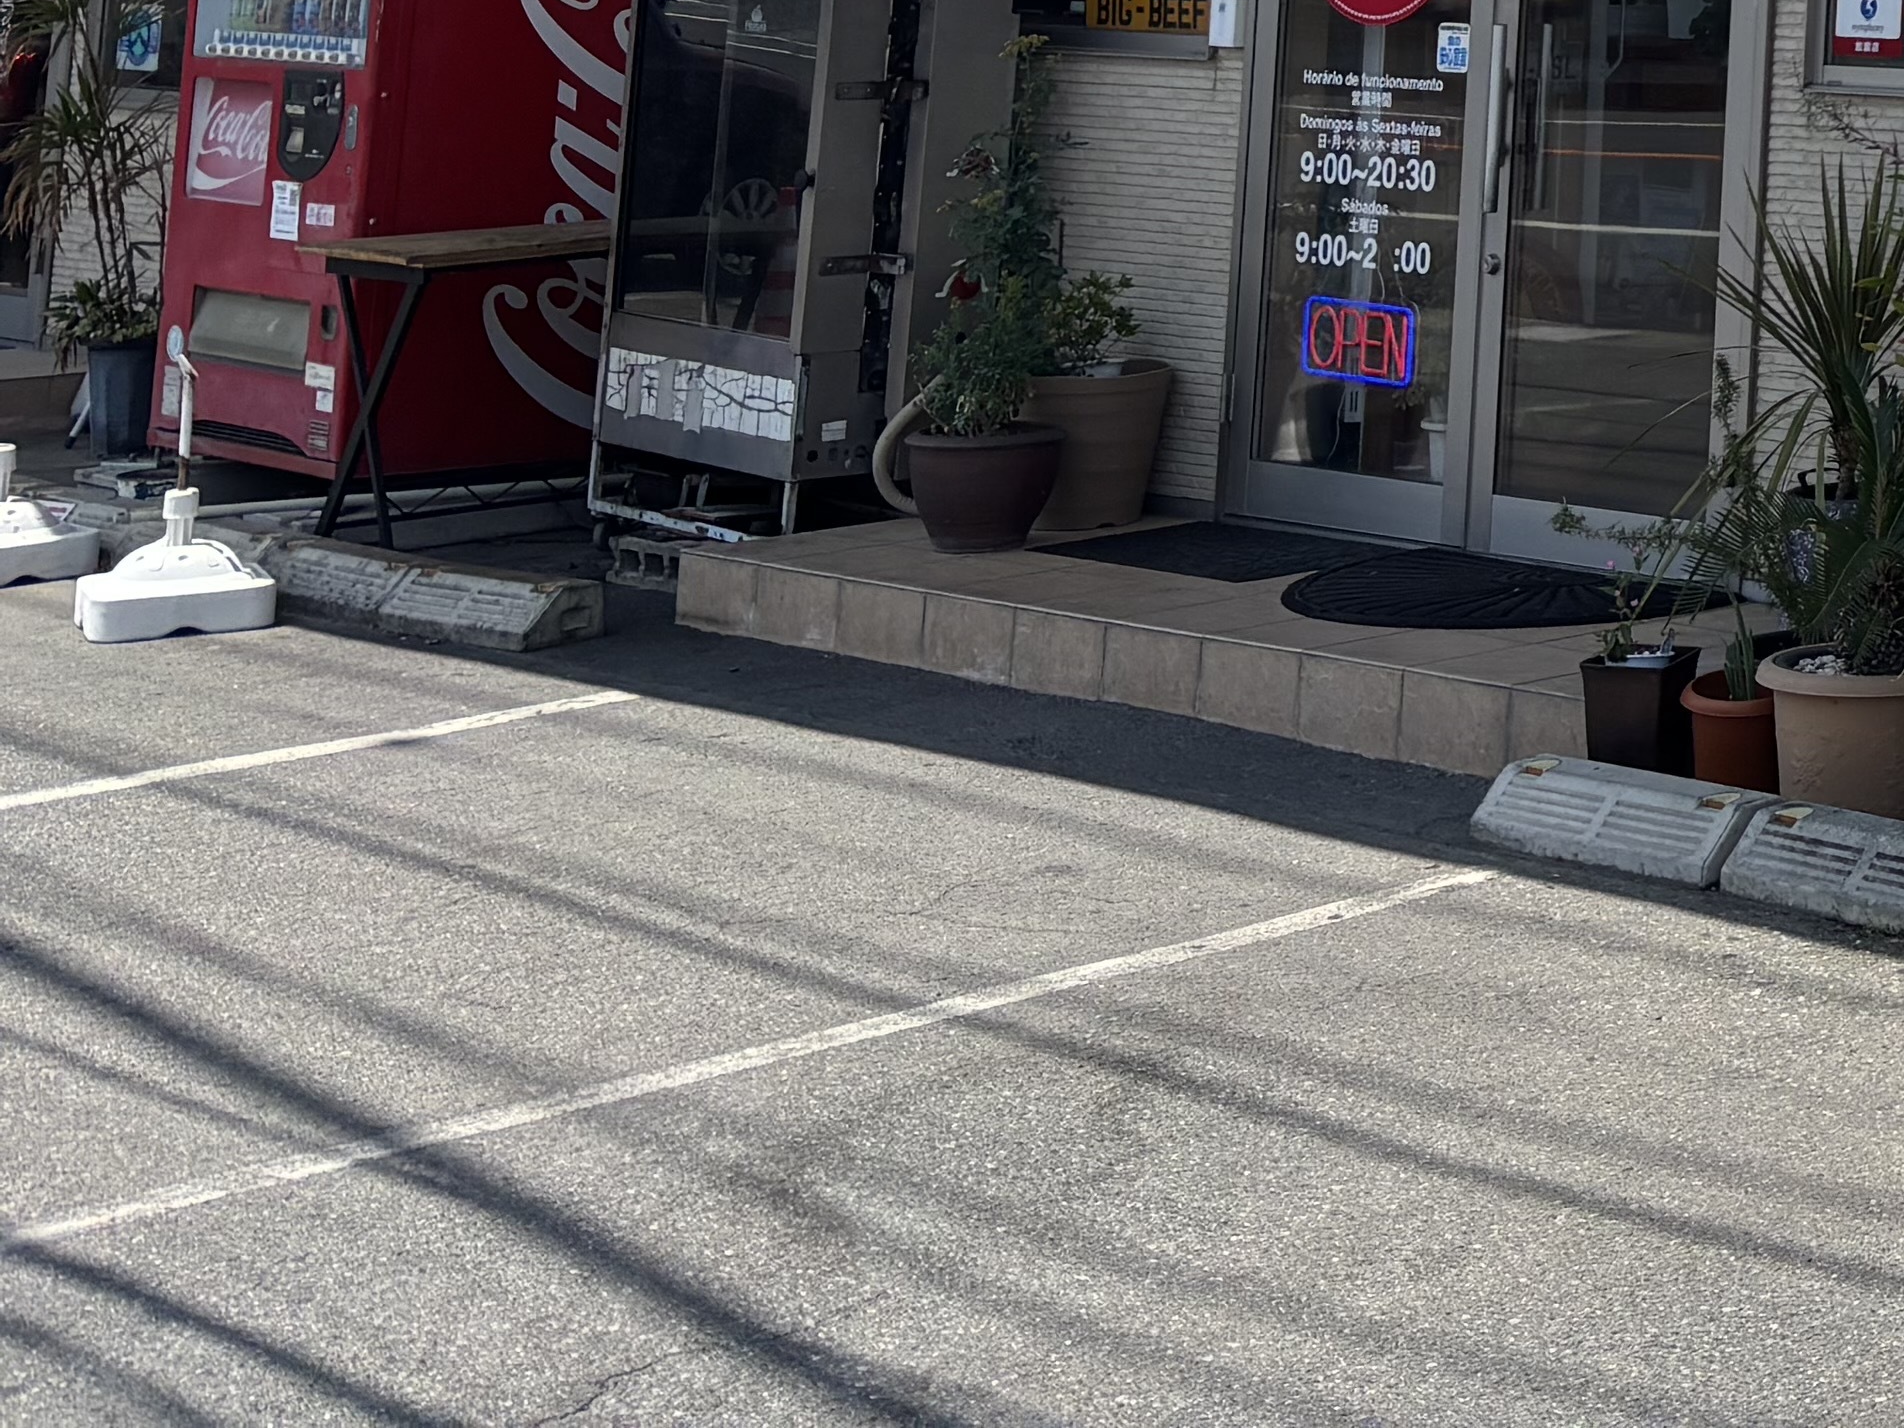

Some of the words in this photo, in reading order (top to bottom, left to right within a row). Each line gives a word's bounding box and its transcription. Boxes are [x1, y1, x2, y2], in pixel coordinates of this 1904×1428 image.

[1345, 72, 1359, 86] de
[1348, 218, 1379, 234] 土曜日
[1309, 305, 1408, 379] OPEN
